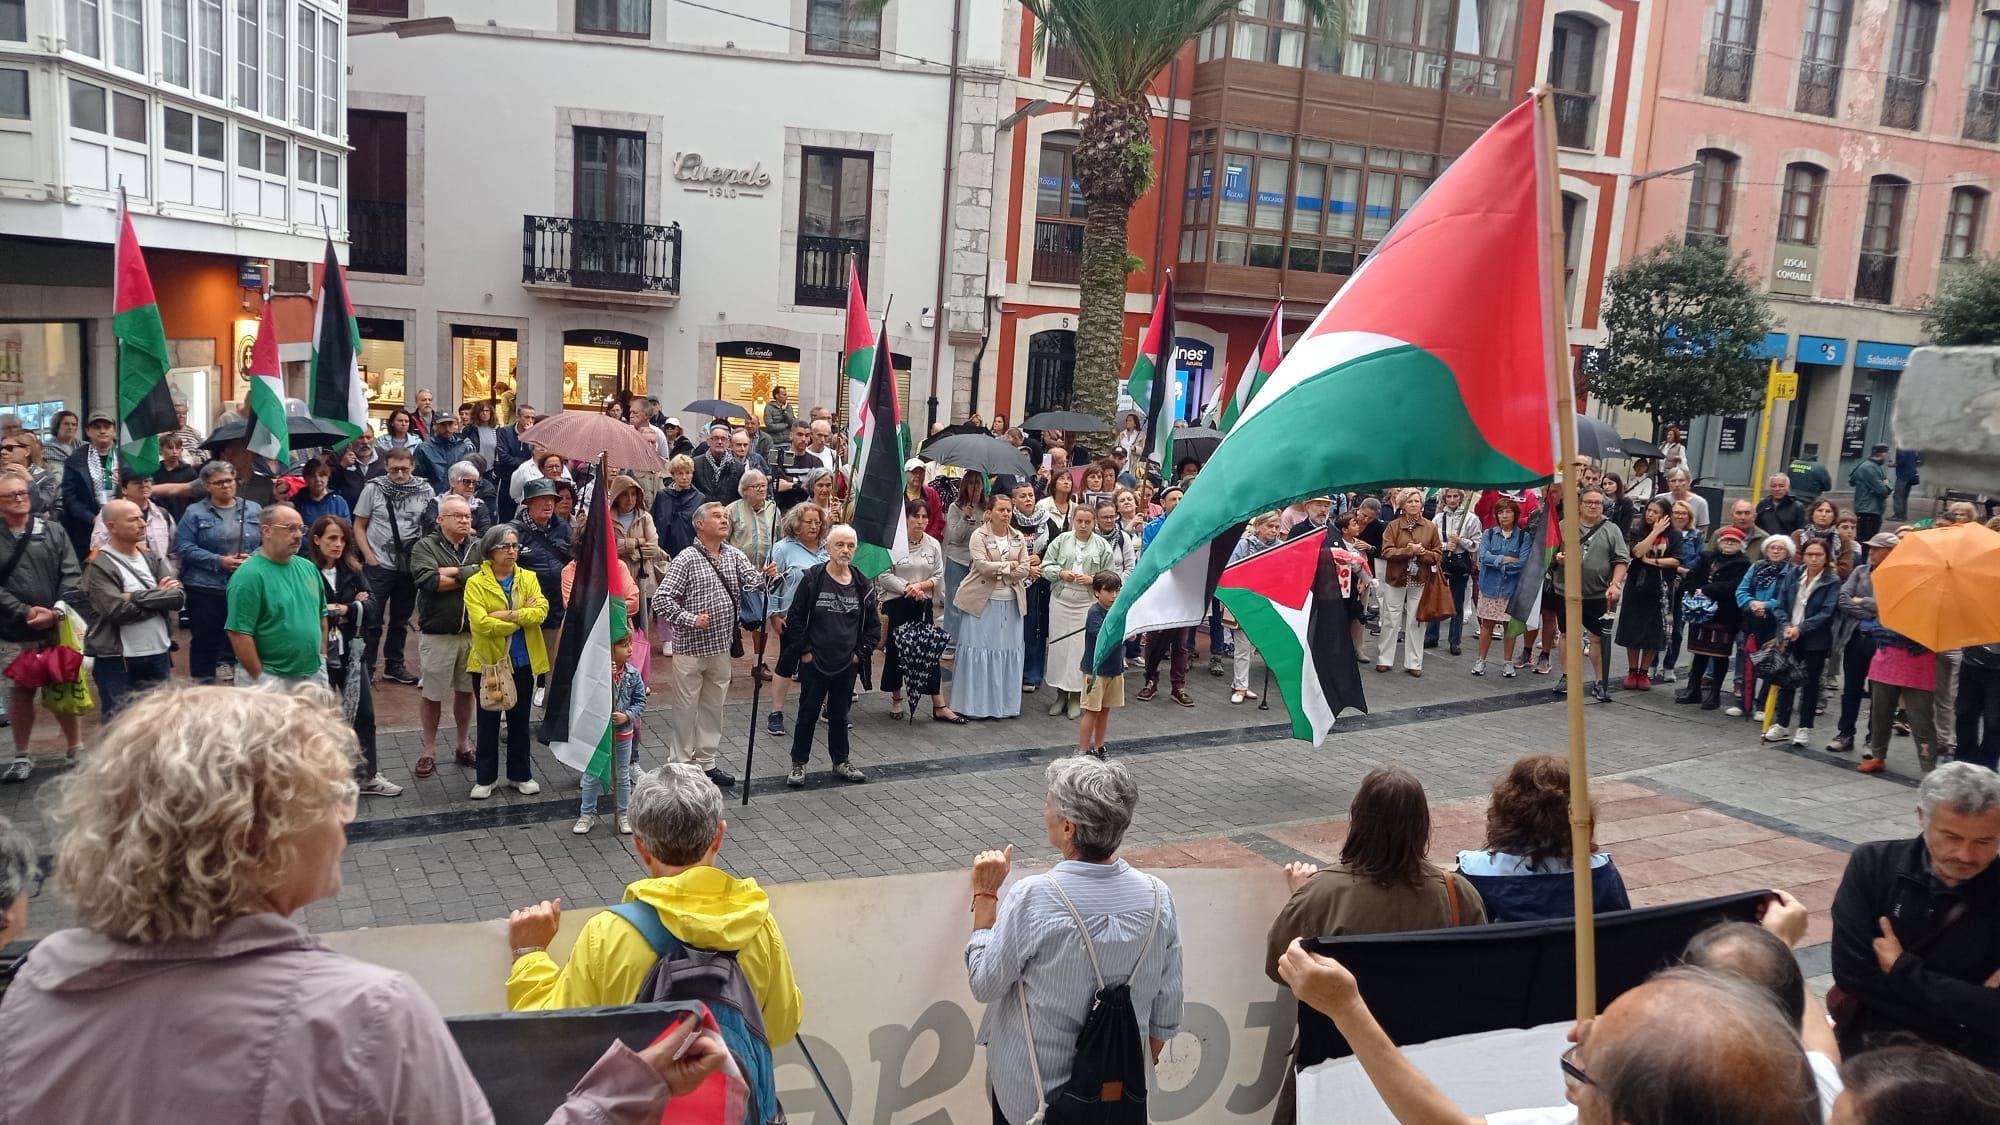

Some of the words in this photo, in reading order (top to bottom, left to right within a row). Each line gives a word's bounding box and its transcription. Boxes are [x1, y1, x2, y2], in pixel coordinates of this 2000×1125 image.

[673, 152, 771, 187] Cuende
[709, 188, 737, 199] 1910
[1783, 258, 1807, 269] FISCAL
[1776, 270, 1812, 282] CONTABLE
[1062, 317, 1069, 328] 5
